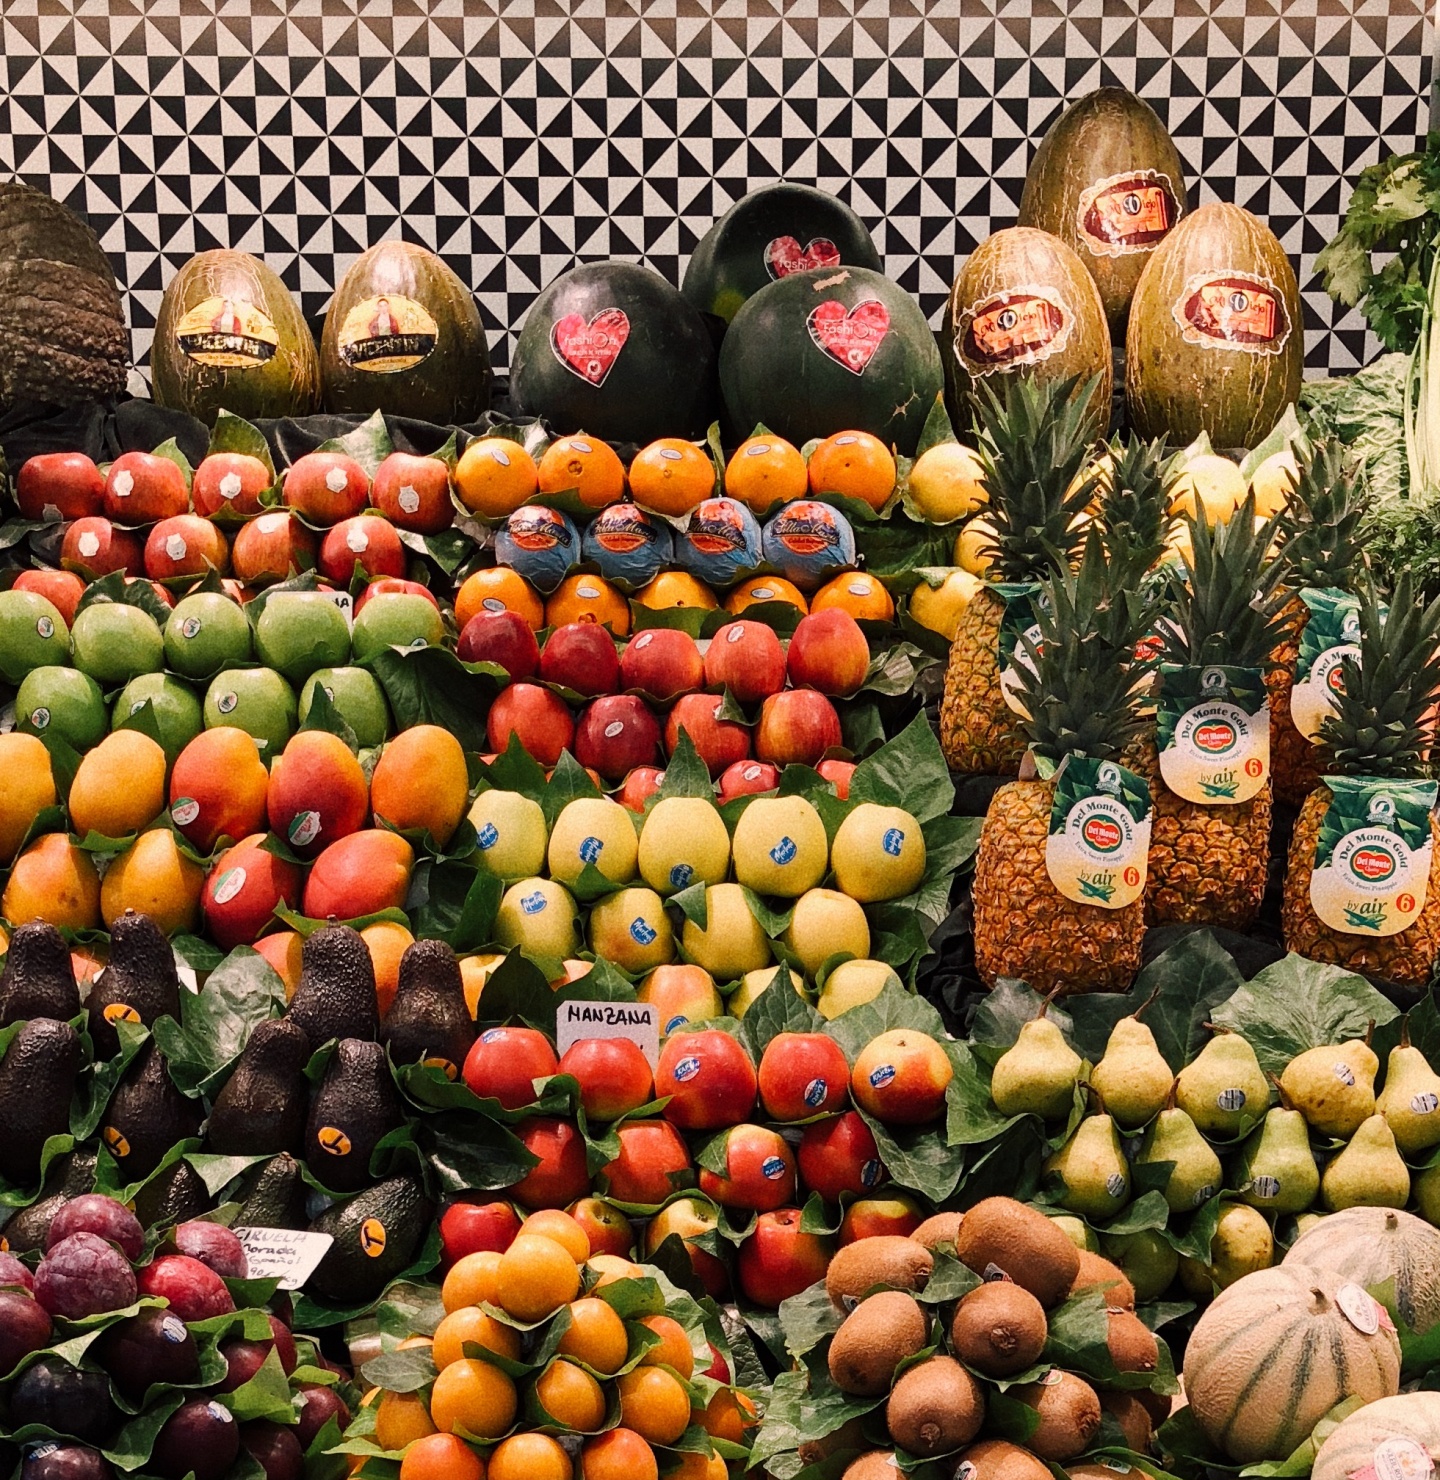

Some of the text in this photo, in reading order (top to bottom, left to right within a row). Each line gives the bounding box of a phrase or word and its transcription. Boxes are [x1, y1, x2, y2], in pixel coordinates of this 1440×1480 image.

[1182, 707, 1248, 738] Del Monte Gold
[1201, 768, 1237, 784] by air
[1249, 760, 1259, 777] 6
[1072, 802, 1132, 841] Del Monte Gold
[1339, 834, 1408, 868] Del Monte Gold
[1081, 870, 1116, 885] by air
[1127, 869, 1137, 885] 6
[1360, 899, 1387, 914] air
[1400, 895, 1411, 911] 6
[568, 1005, 651, 1025] MANZANA
